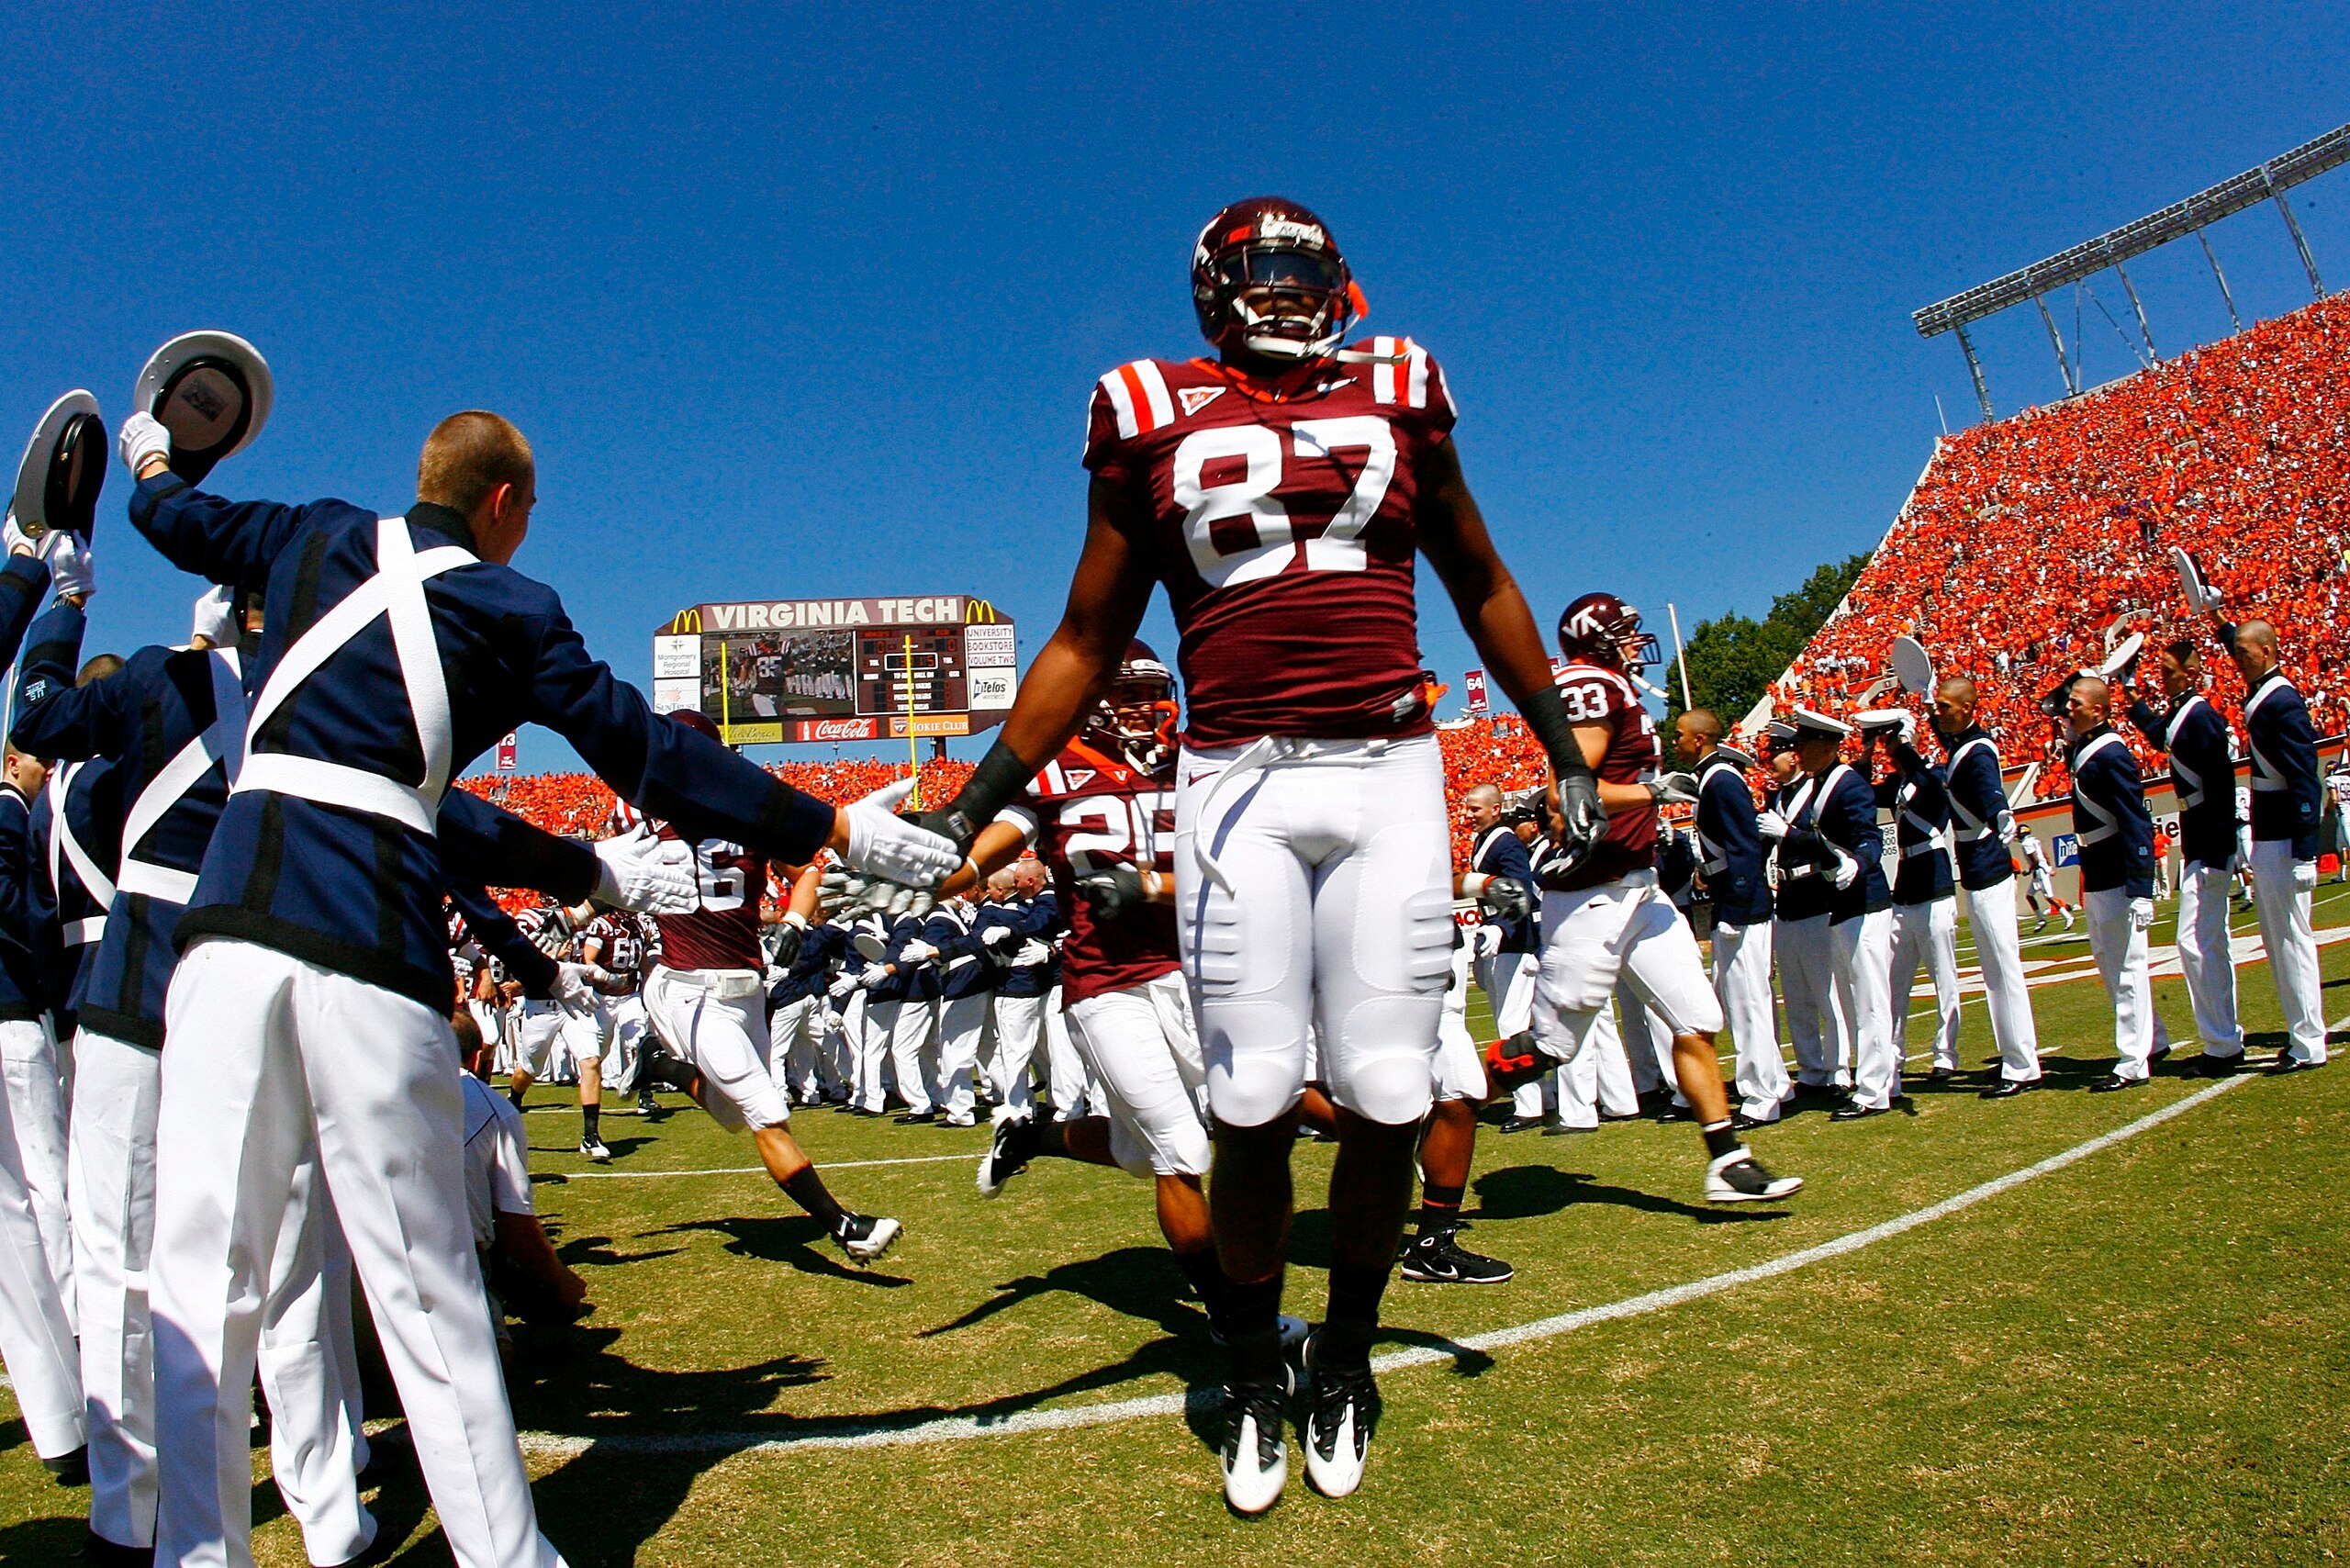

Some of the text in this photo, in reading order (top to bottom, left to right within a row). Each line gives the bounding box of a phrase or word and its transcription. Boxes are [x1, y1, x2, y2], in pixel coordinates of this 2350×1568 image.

[1173, 415, 1398, 588] 87
[711, 599, 958, 629] VIRGINIA TECH
[968, 628, 1013, 637] UNIVERSITY
[968, 641, 1013, 651] BOOKSTORE
[968, 655, 1015, 665] VOLUME TWO
[1467, 677, 1483, 690] 64
[1560, 682, 1609, 722] 33
[815, 718, 872, 739] Coca-Cola
[943, 721, 968, 731] CLUB
[611, 937, 643, 969] 60
